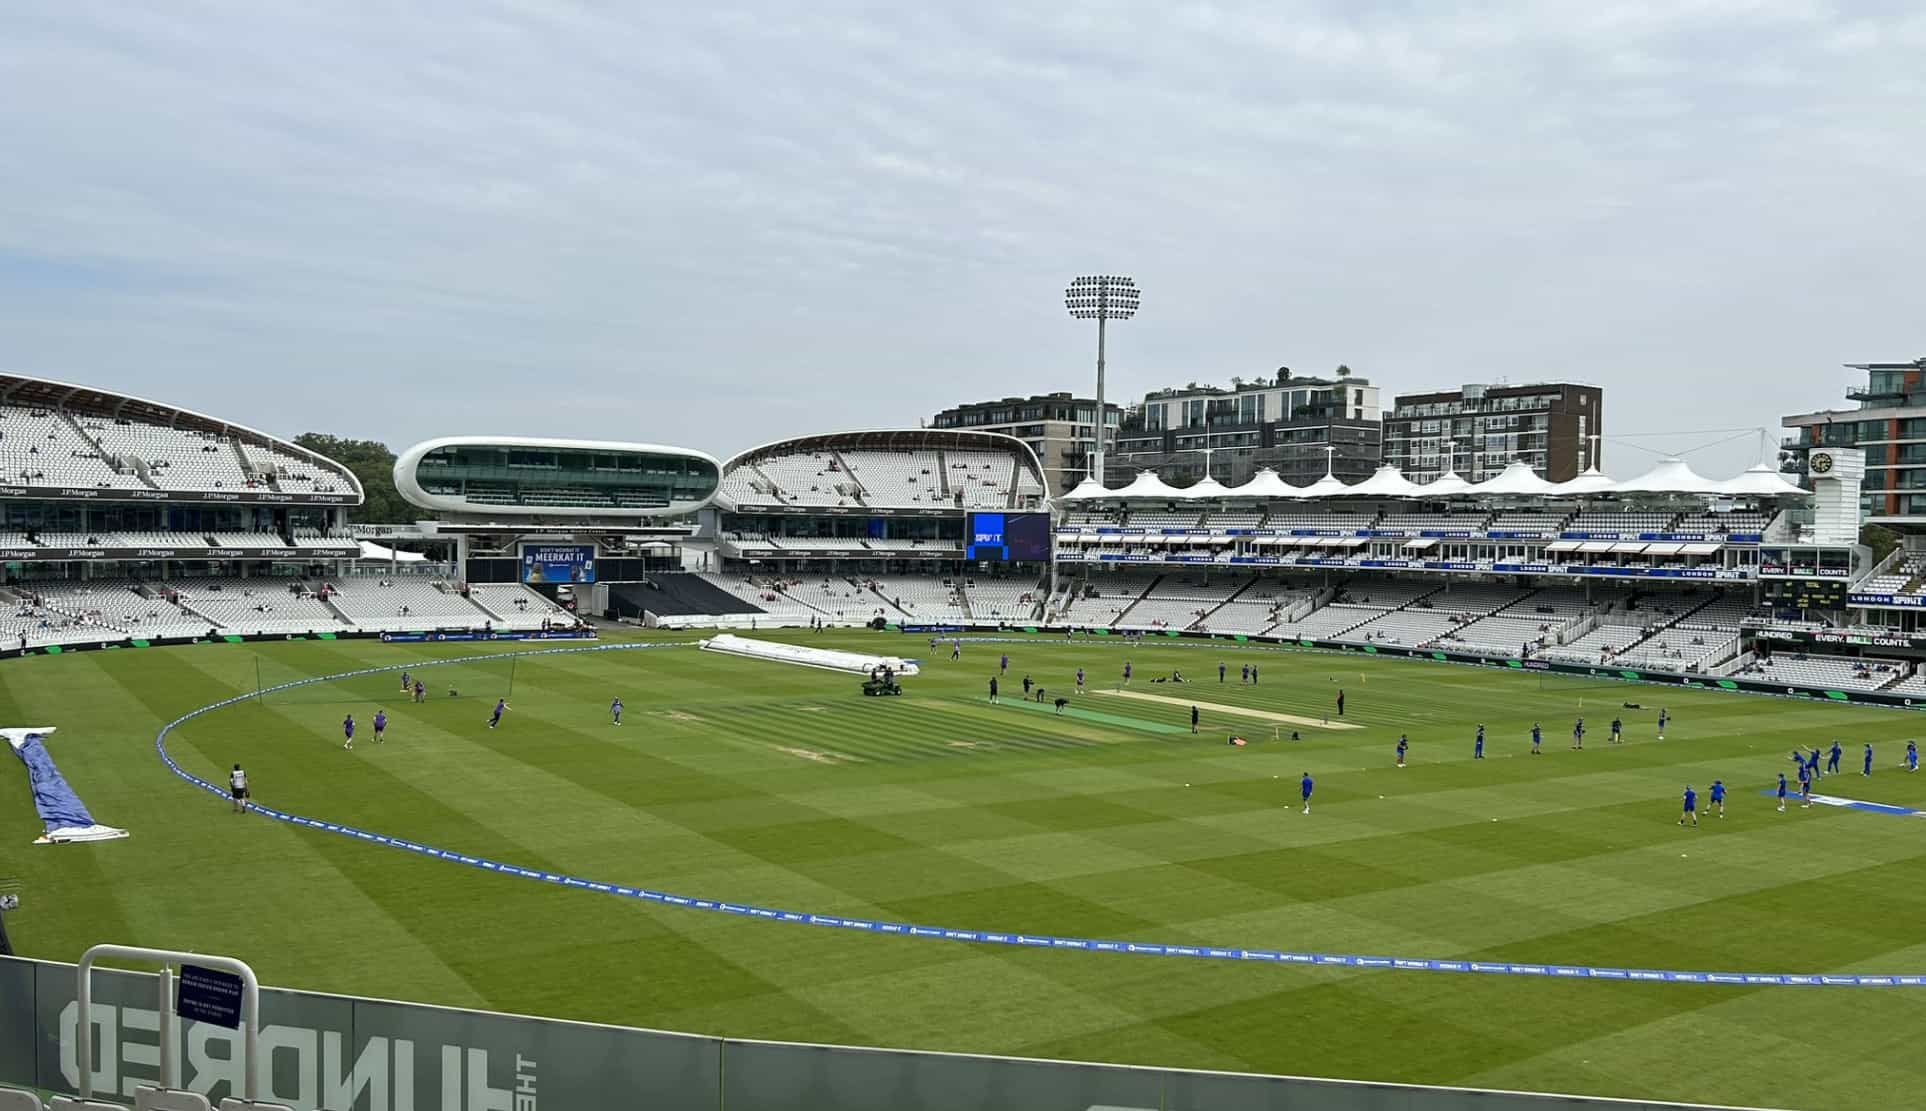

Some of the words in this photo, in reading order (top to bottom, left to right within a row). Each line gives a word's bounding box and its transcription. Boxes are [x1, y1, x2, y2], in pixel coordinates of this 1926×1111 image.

[535, 552, 575, 562] MEERKAT
[576, 552, 585, 563] IT
[1873, 637, 1913, 648] COUNTS.
